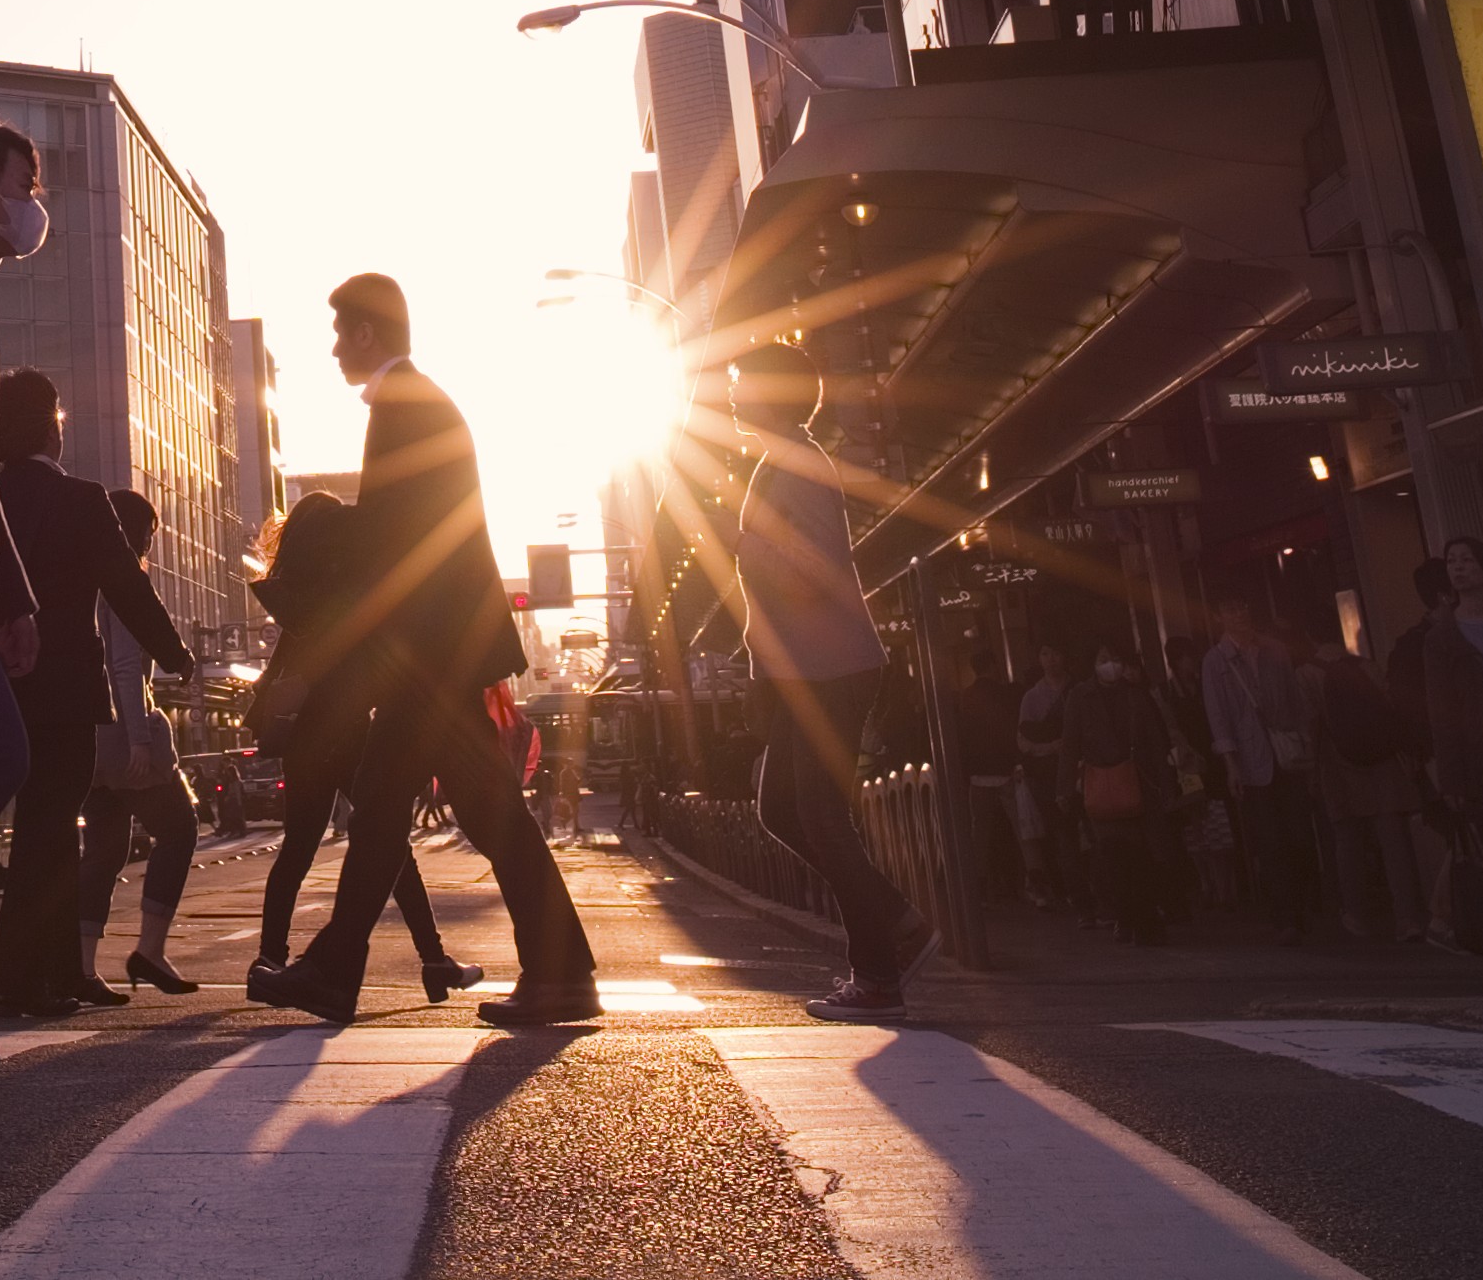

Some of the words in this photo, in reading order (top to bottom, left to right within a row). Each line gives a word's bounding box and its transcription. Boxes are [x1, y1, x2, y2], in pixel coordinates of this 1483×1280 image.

[1290, 345, 1420, 379] nikiniki
[1108, 474, 1180, 489] handkerchief
[1123, 488, 1170, 500] BAKERY
